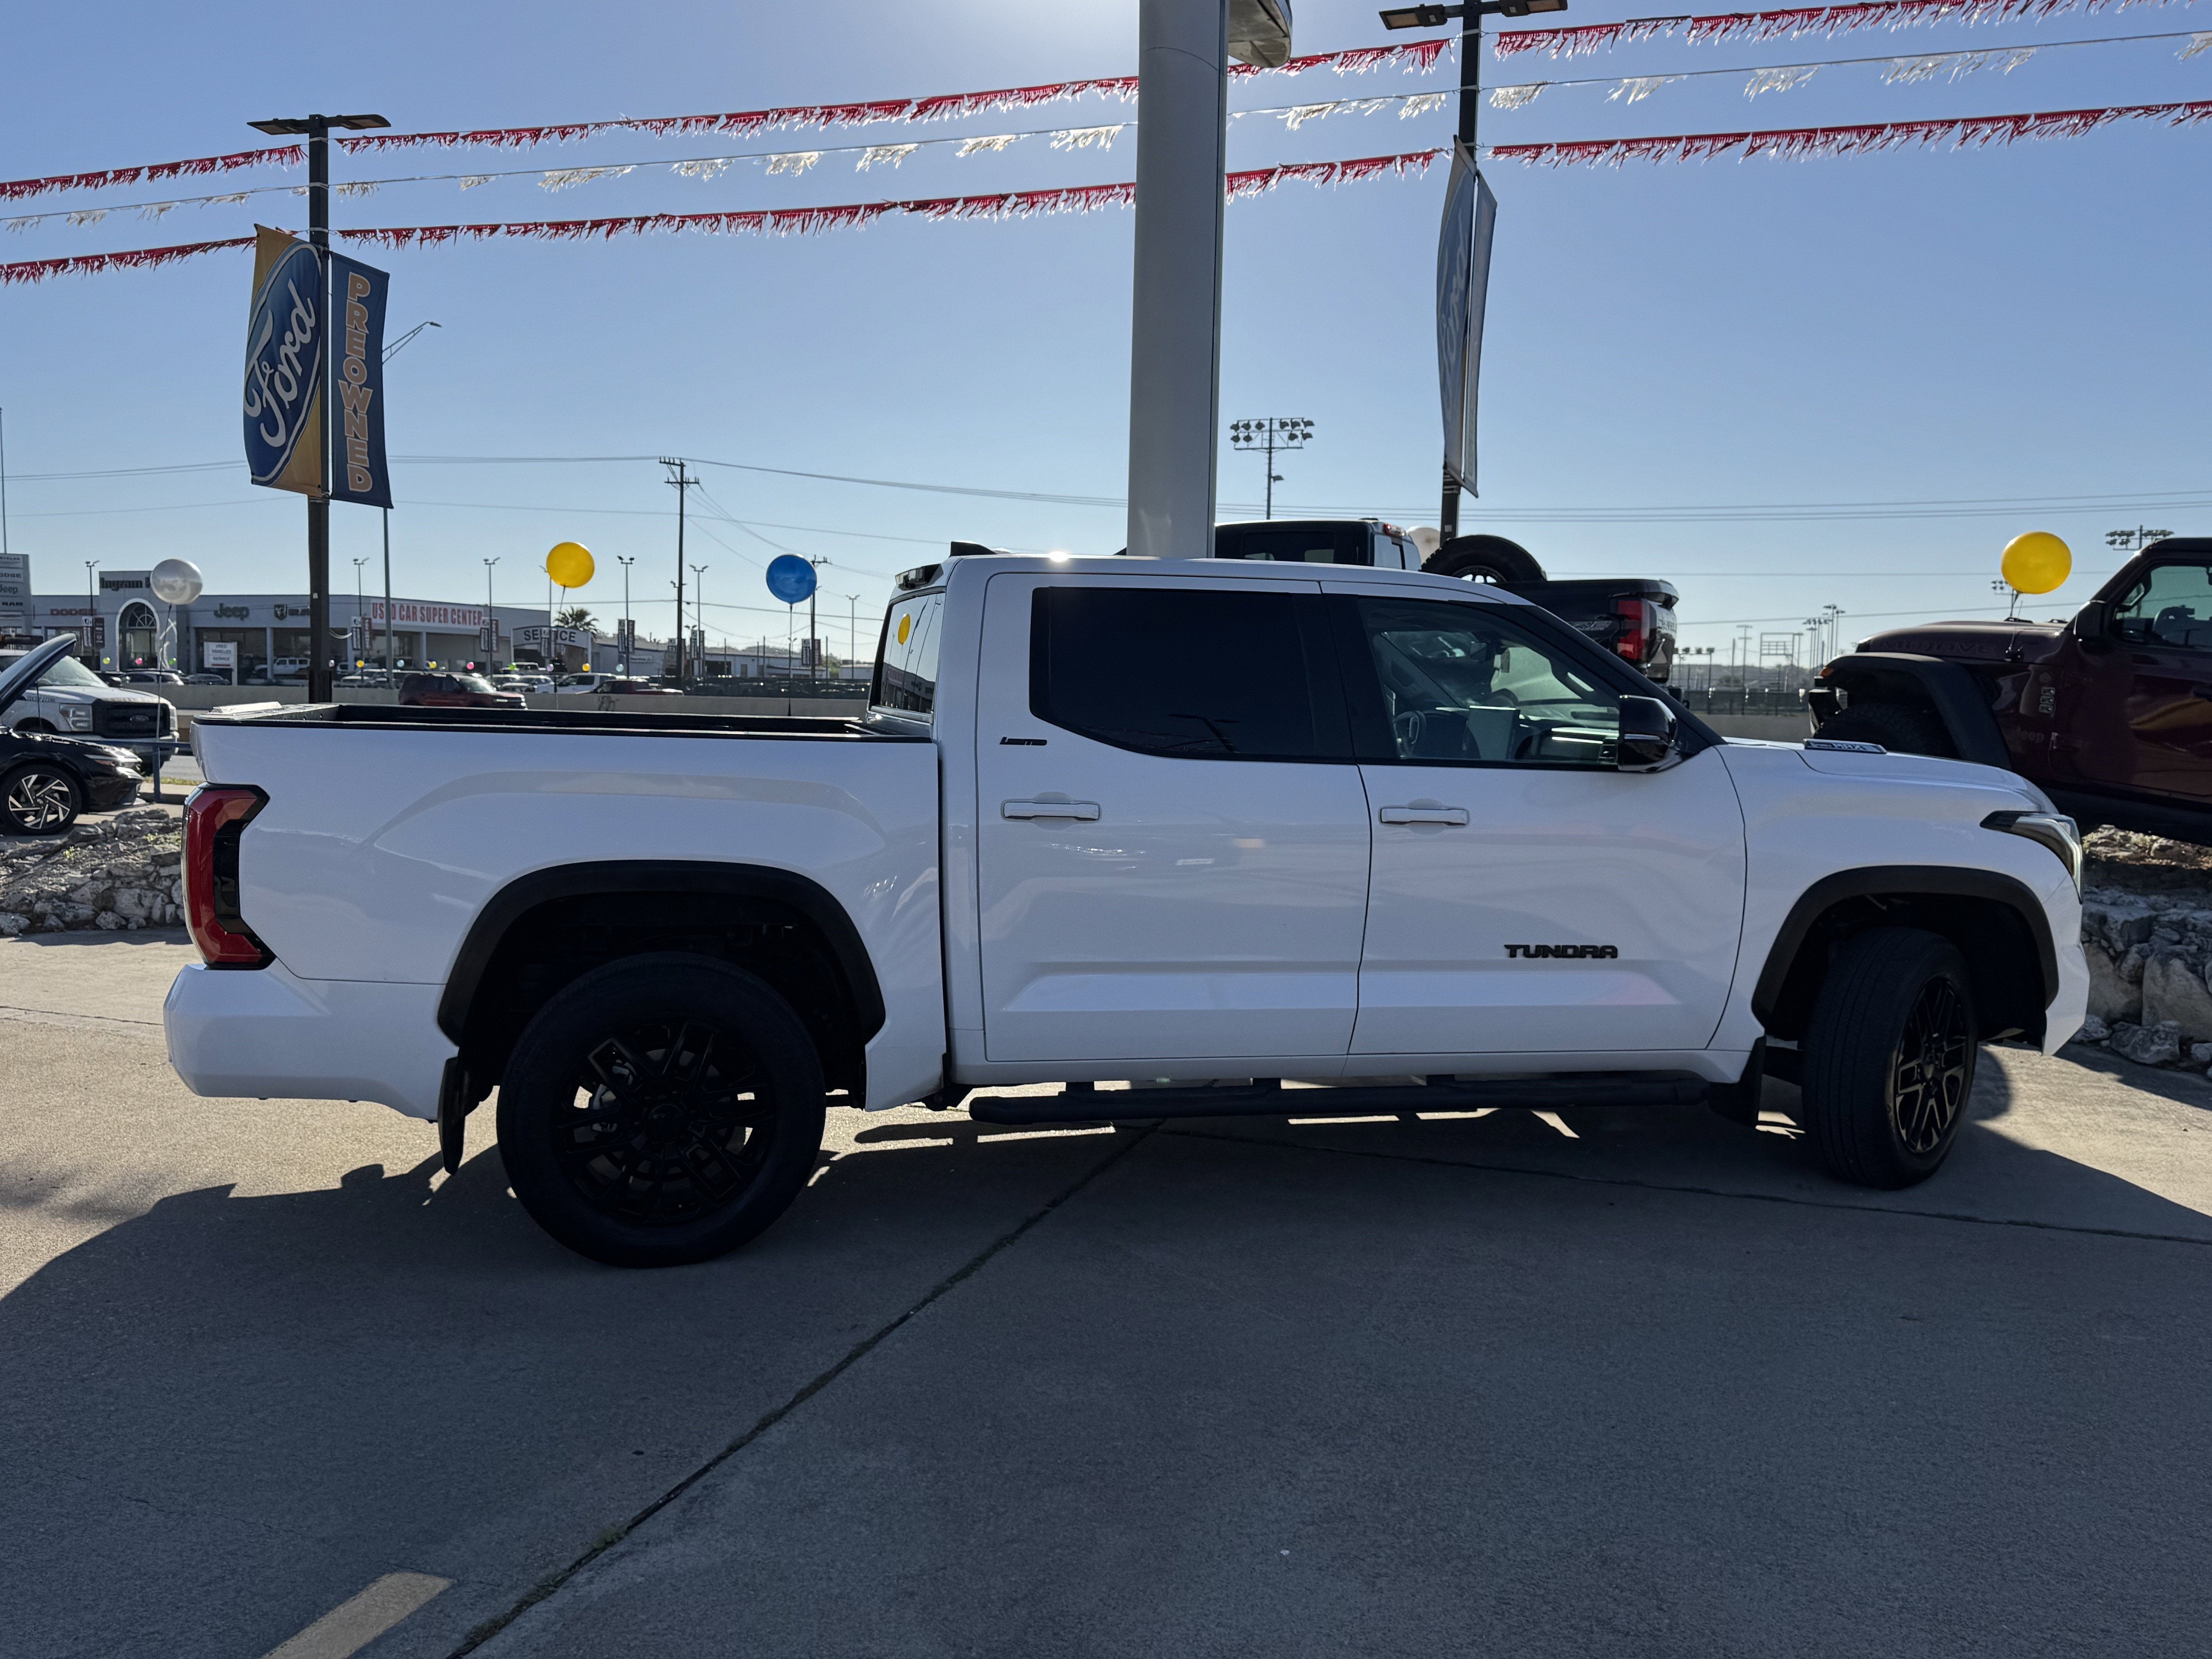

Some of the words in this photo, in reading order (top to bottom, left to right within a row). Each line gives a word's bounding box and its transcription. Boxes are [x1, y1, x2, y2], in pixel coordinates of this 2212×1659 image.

[244, 277, 316, 447] Ford
[338, 271, 373, 492] PREOWNED
[214, 603, 250, 620] Jeep
[372, 603, 396, 620] USD
[399, 605, 417, 621] CAR
[420, 606, 448, 623] SUPER
[451, 608, 483, 626] CENTER
[1504, 944, 1618, 958] TUNDRA
